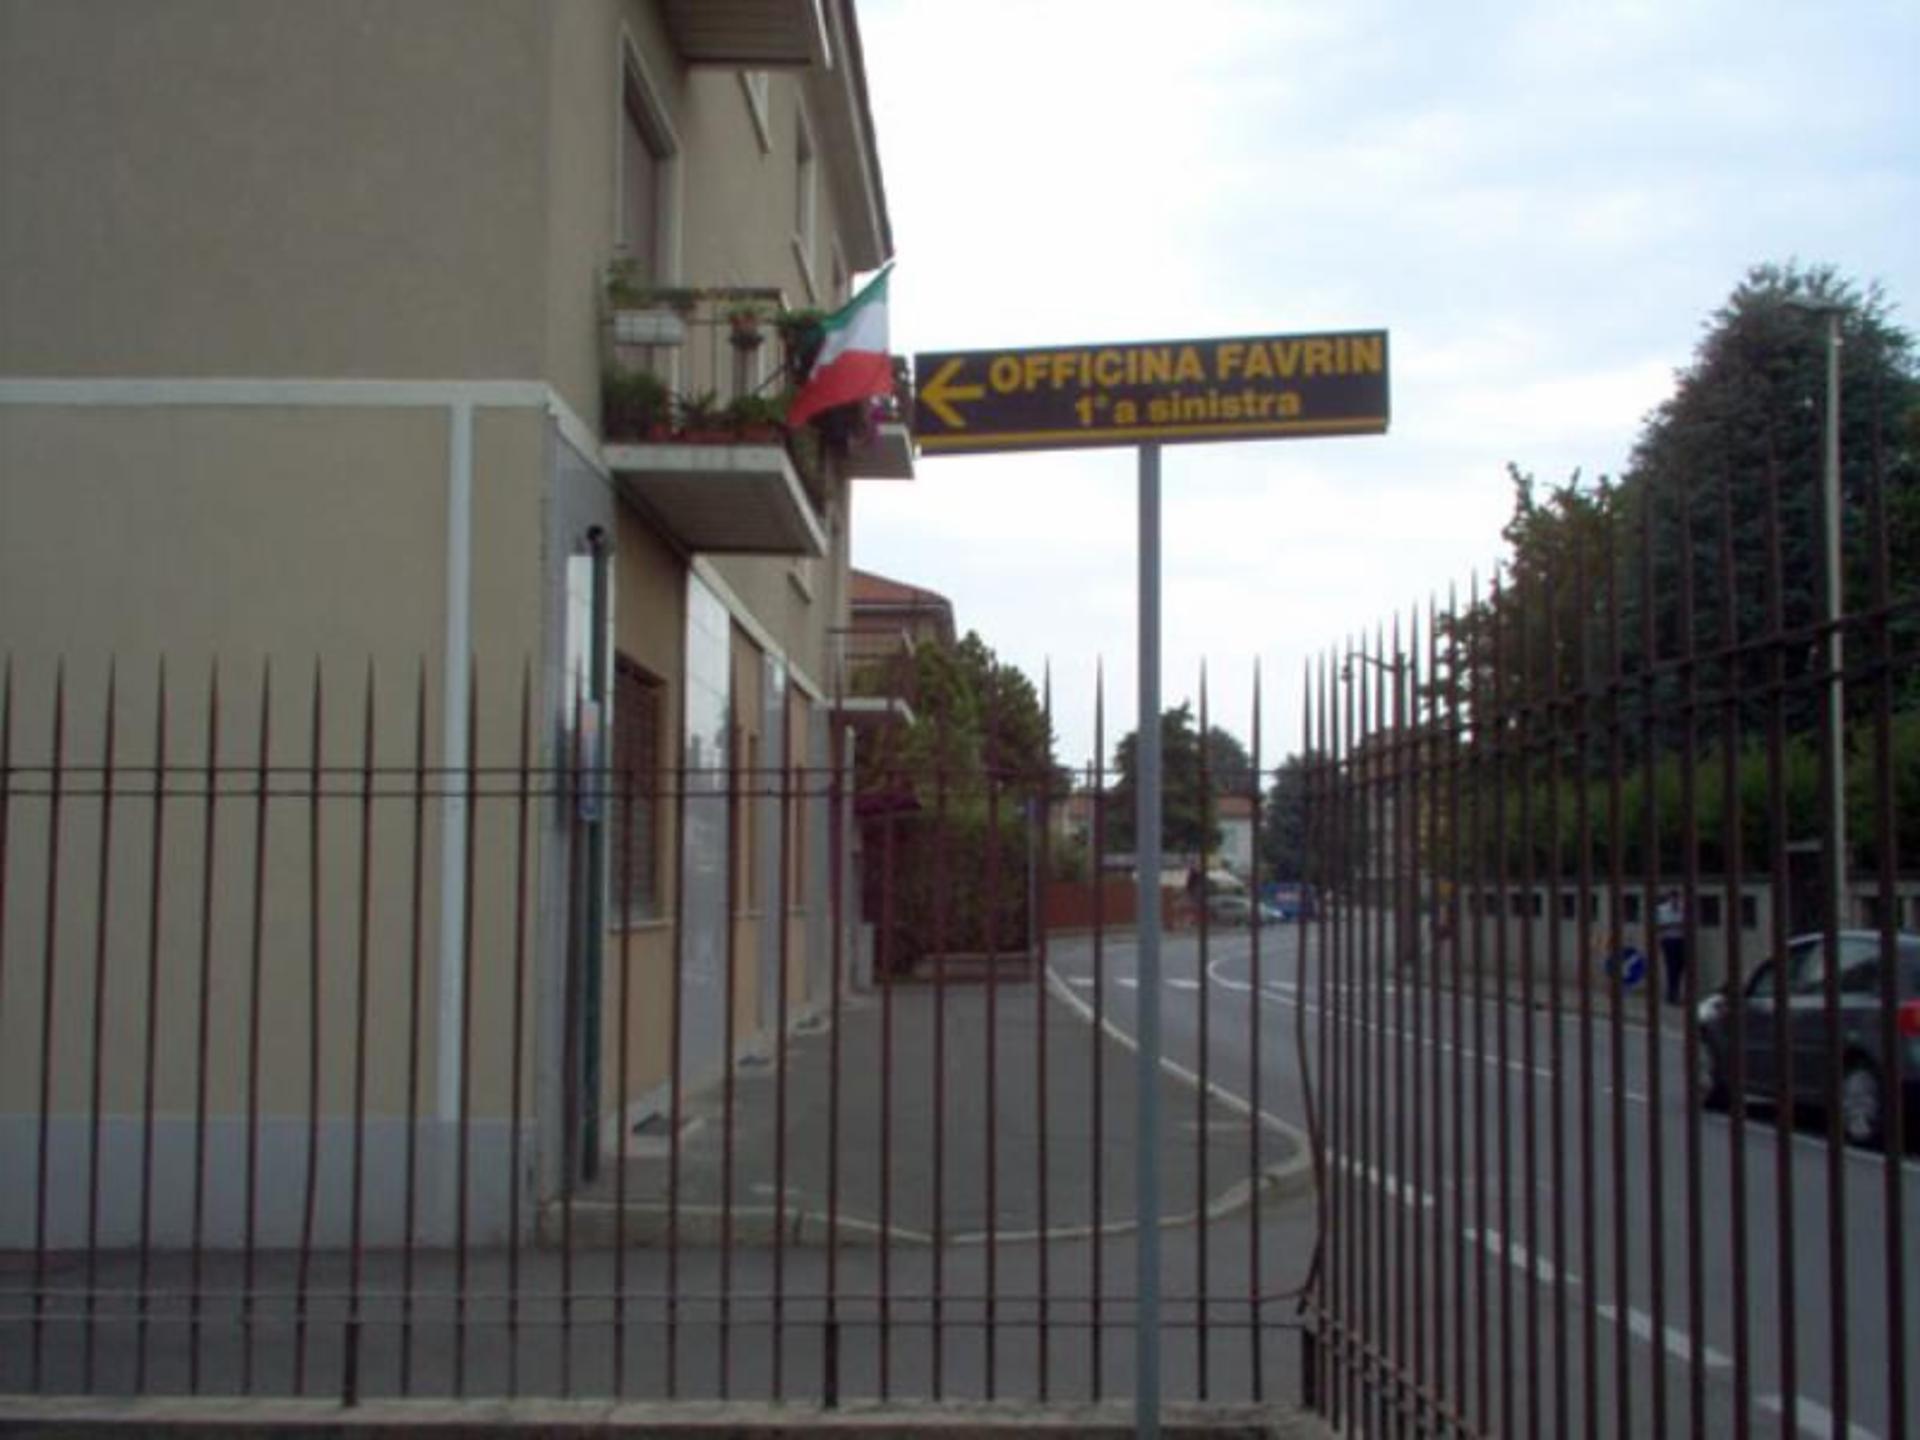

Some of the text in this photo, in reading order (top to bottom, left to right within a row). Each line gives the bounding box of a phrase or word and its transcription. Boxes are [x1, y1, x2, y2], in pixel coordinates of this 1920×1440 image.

[988, 337, 1382, 392] OFFICINA FAVRIN
[1148, 388, 1301, 423] sinistra
